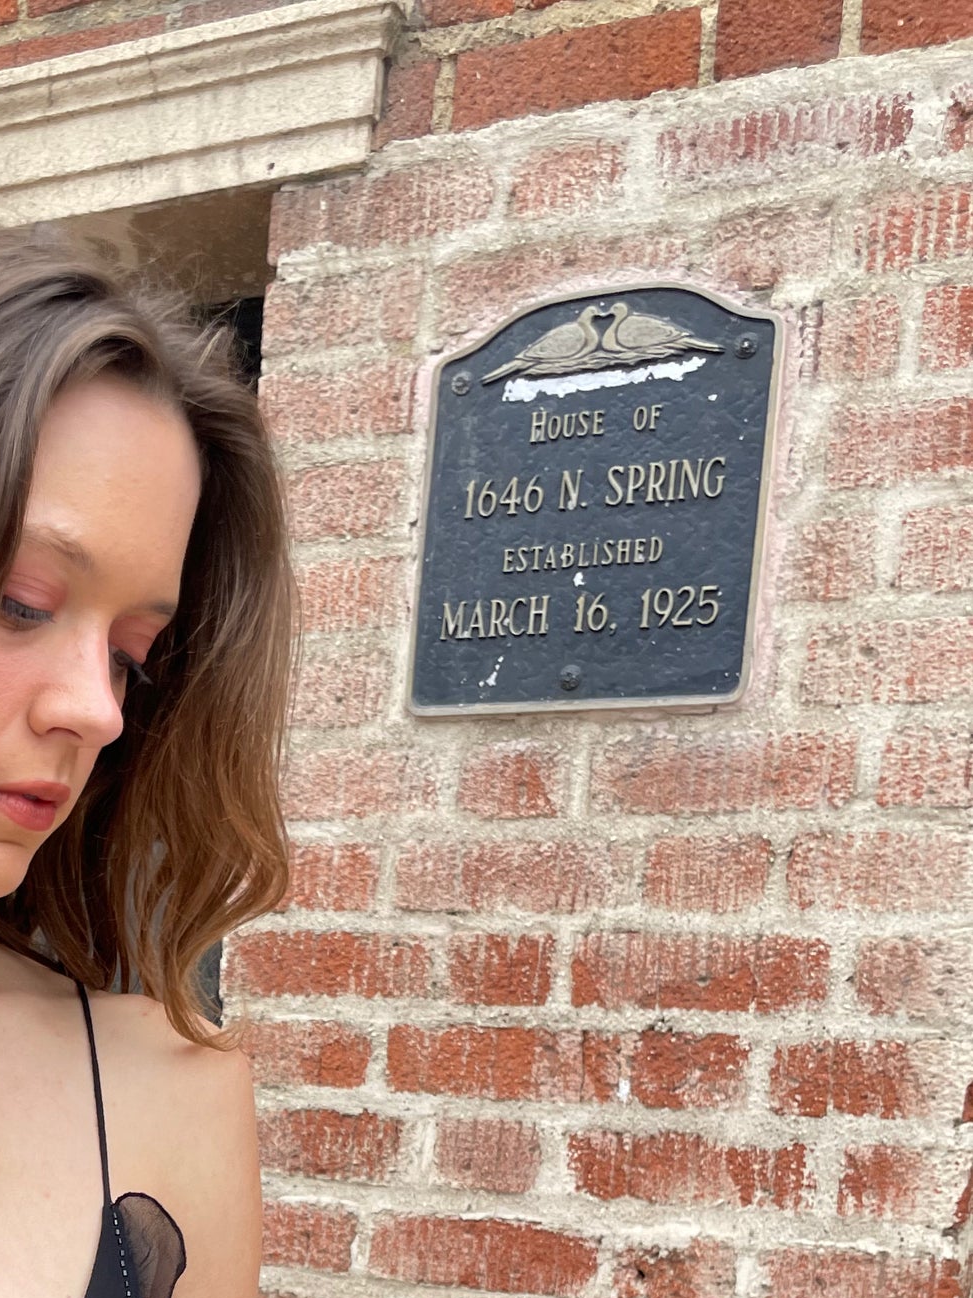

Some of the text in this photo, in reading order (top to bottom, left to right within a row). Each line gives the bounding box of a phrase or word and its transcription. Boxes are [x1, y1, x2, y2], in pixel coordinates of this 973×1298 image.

[633, 404, 664, 431] OF
[464, 456, 727, 520] 1646 N. SPRING
[502, 536, 664, 574] ESTABLISHED
[439, 594, 550, 641] MARCH
[639, 584, 722, 629] 1925
